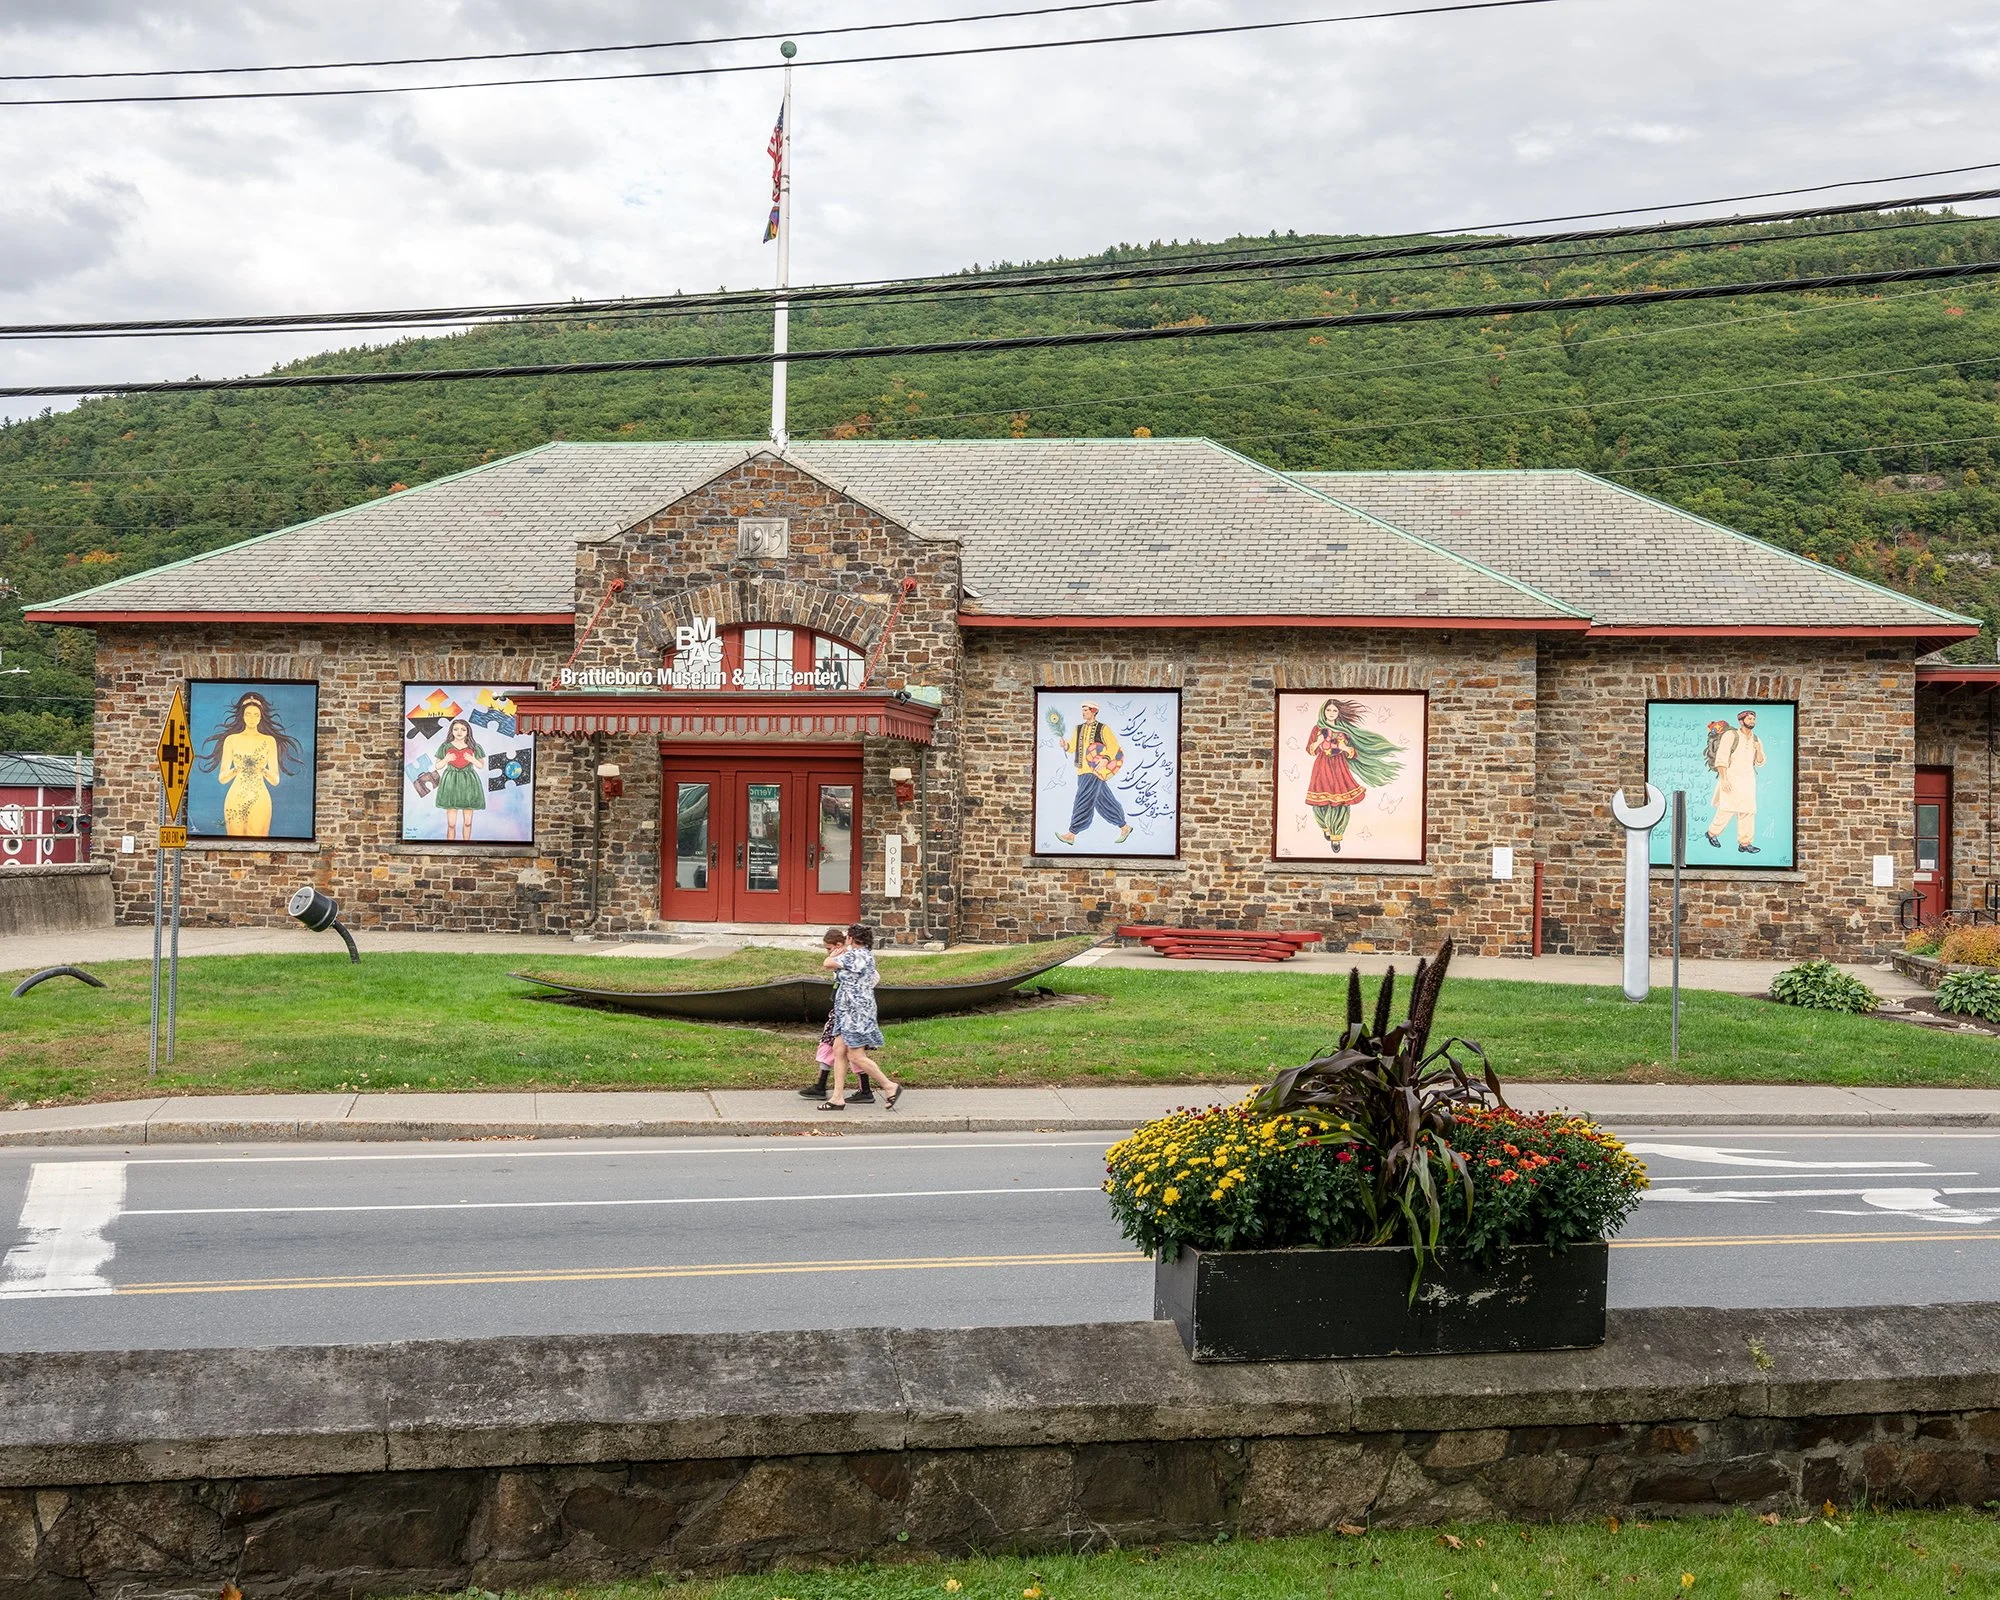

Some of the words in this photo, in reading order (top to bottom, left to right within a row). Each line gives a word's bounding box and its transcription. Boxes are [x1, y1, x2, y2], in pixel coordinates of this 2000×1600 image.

[744, 527, 783, 553] 1915
[560, 667, 653, 686] Brattleboro
[657, 667, 727, 686] Museum
[731, 668, 745, 686] &
[750, 668, 776, 686] Art
[782, 668, 839, 686] Center
[161, 831, 171, 843] DEAD
[171, 831, 179, 843] END
[889, 846, 897, 885] OPEN
